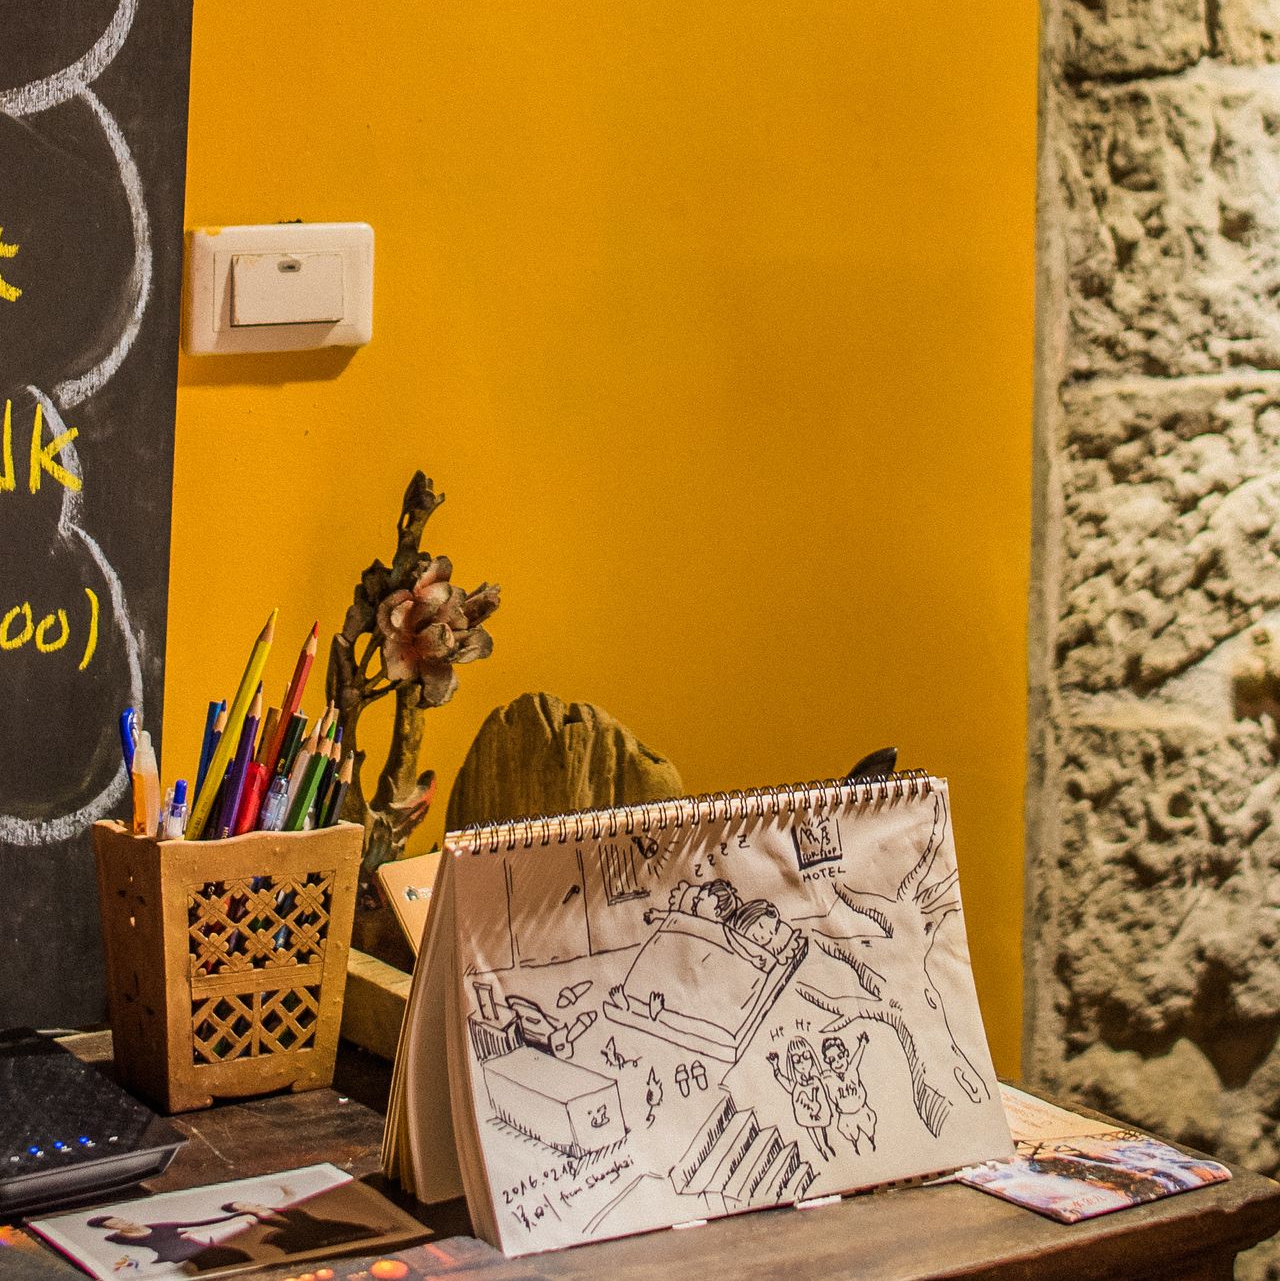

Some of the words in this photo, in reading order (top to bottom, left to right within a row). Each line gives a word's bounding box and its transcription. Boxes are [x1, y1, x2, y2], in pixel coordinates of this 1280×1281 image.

[802, 867, 846, 882] HOTEL
[795, 1019, 811, 1032] Hi
[770, 1026, 784, 1041] Hi
